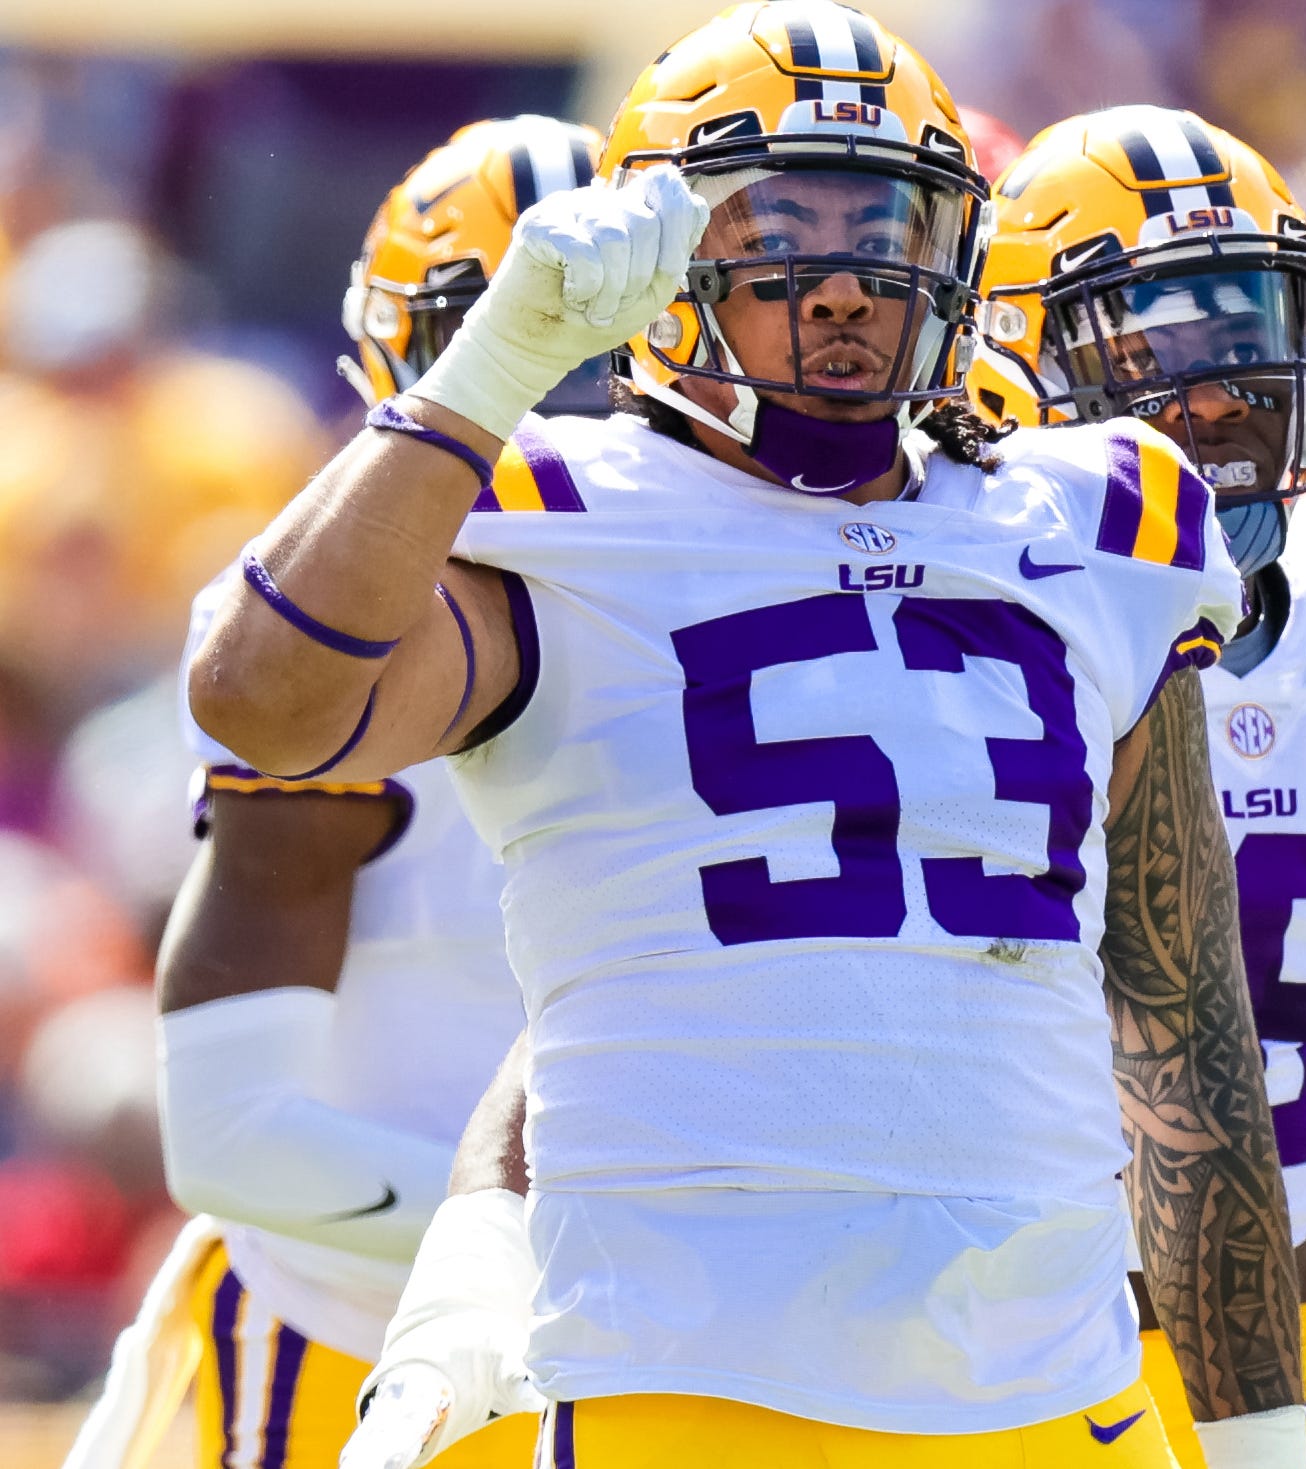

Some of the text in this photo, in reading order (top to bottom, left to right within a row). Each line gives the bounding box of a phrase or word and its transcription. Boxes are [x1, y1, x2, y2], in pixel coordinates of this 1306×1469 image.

[813, 100, 882, 128] LSU
[1165, 207, 1234, 236] LSU
[844, 522, 896, 553] SEC
[838, 563, 926, 592] LSU
[1229, 706, 1274, 757] SEC
[669, 592, 1094, 946] 53
[1222, 788, 1298, 819] LSU
